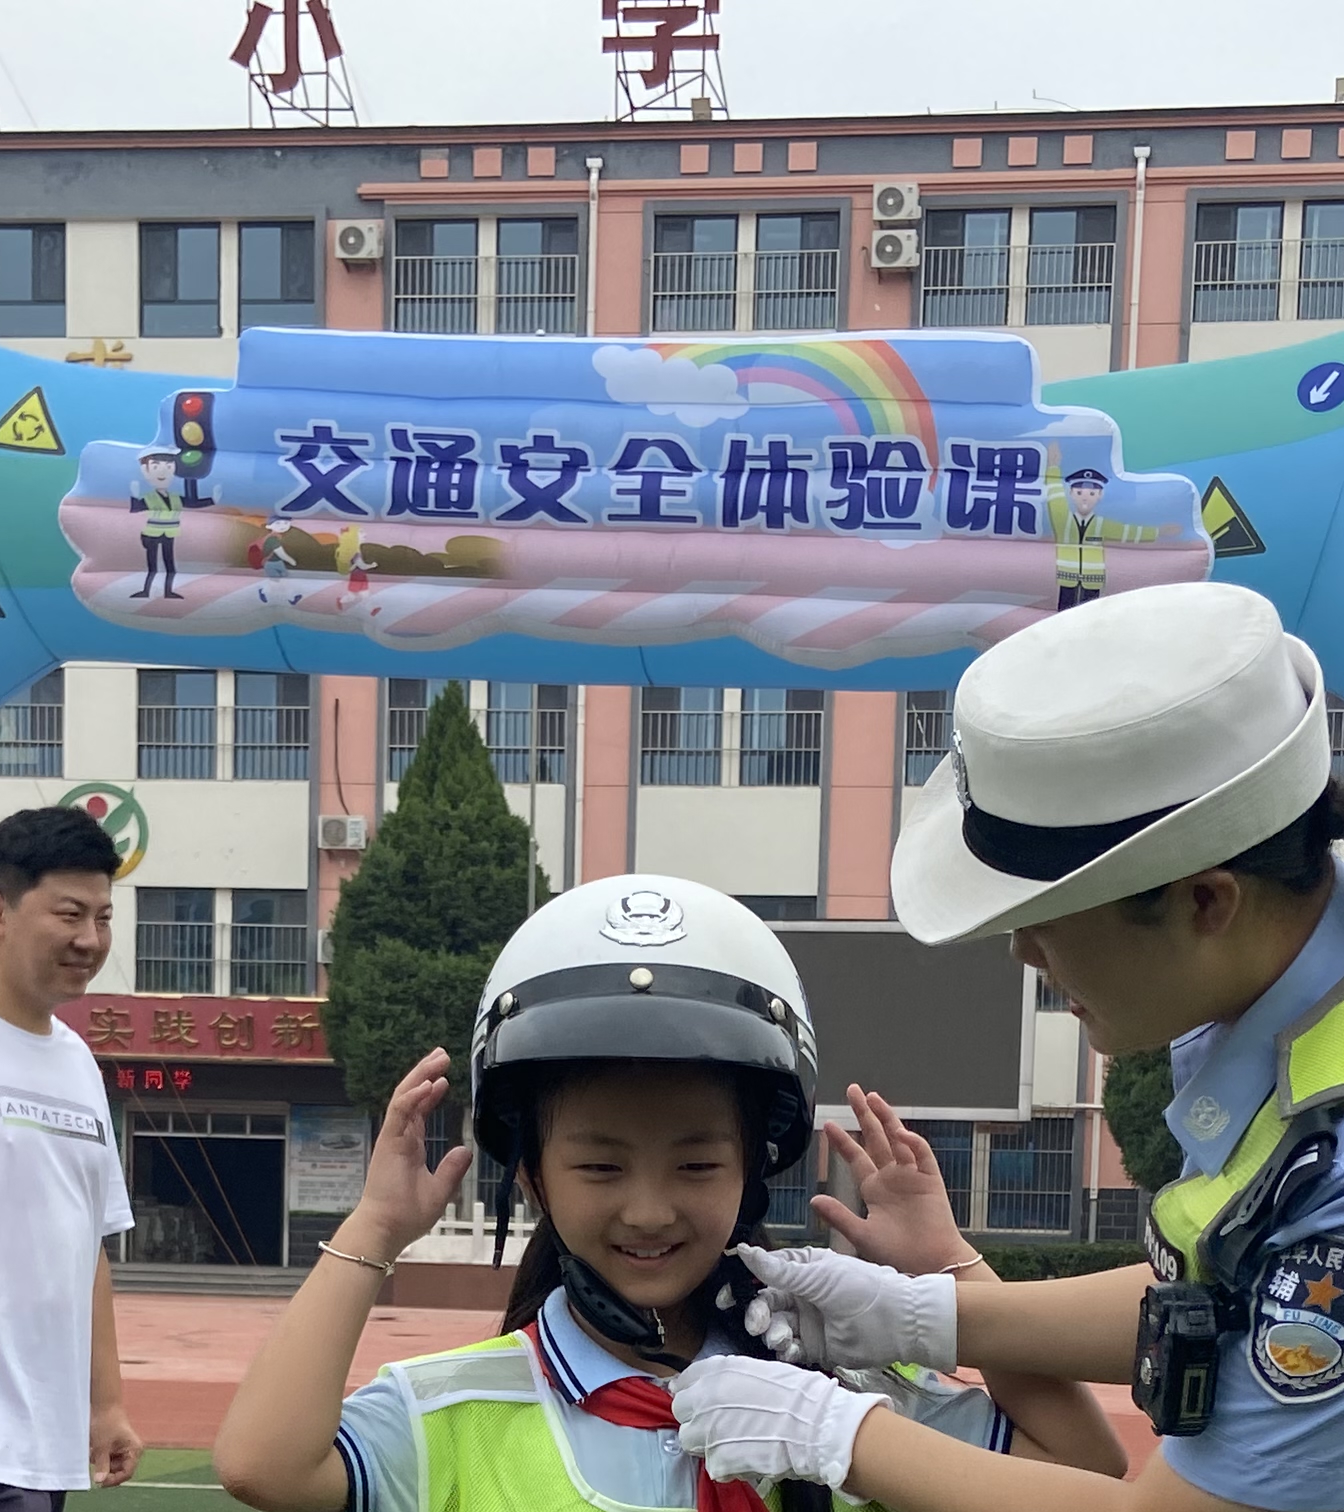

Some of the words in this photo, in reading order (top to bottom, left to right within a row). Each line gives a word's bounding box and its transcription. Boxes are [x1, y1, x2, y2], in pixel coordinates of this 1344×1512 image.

[278, 423, 1043, 536] 交通安全体验课
[86, 1007, 321, 1050] 实践创新
[6, 1102, 96, 1131] ANTATECH
[1268, 1266, 1301, 1302] 辅
[1283, 1310, 1301, 1321] FU
